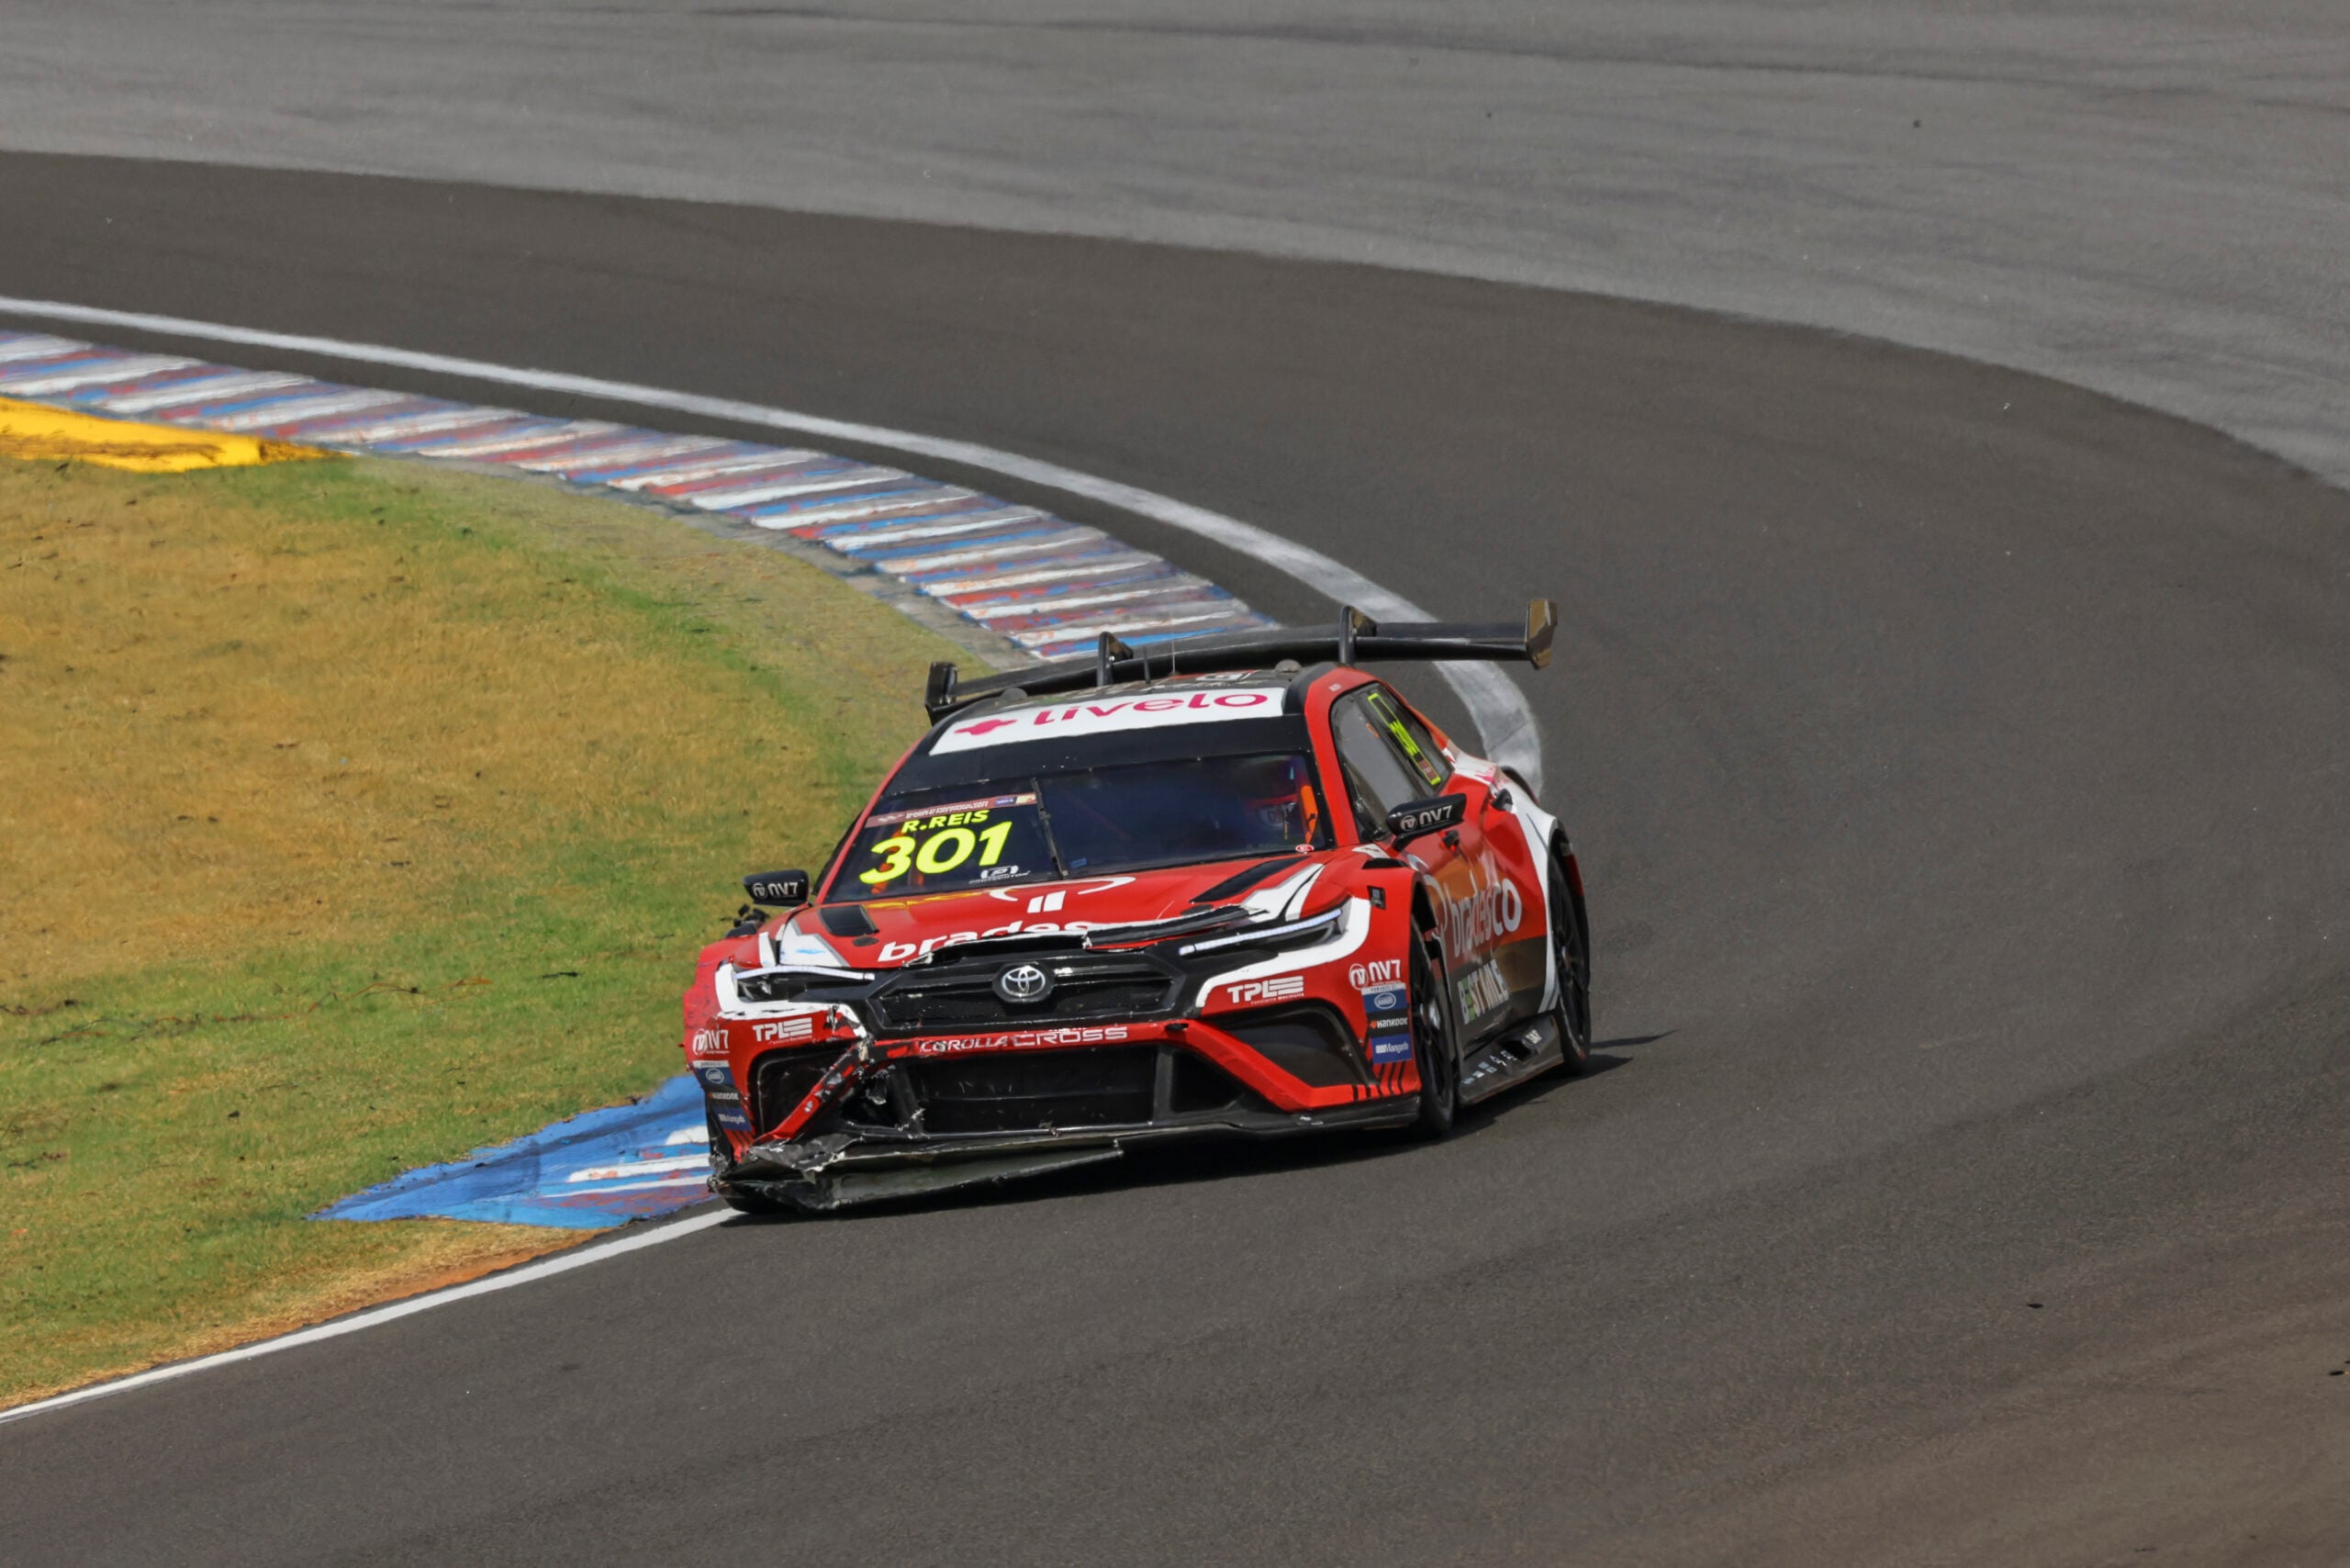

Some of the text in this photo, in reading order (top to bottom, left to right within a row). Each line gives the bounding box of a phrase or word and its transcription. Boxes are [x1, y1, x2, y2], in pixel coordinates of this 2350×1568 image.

[1033, 693, 1269, 725] livelo
[901, 810, 990, 834] R.REIS
[859, 821, 1013, 885] 301
[1445, 878, 1522, 958] bradesco
[920, 1026, 1128, 1053] COROLLA CROSS
